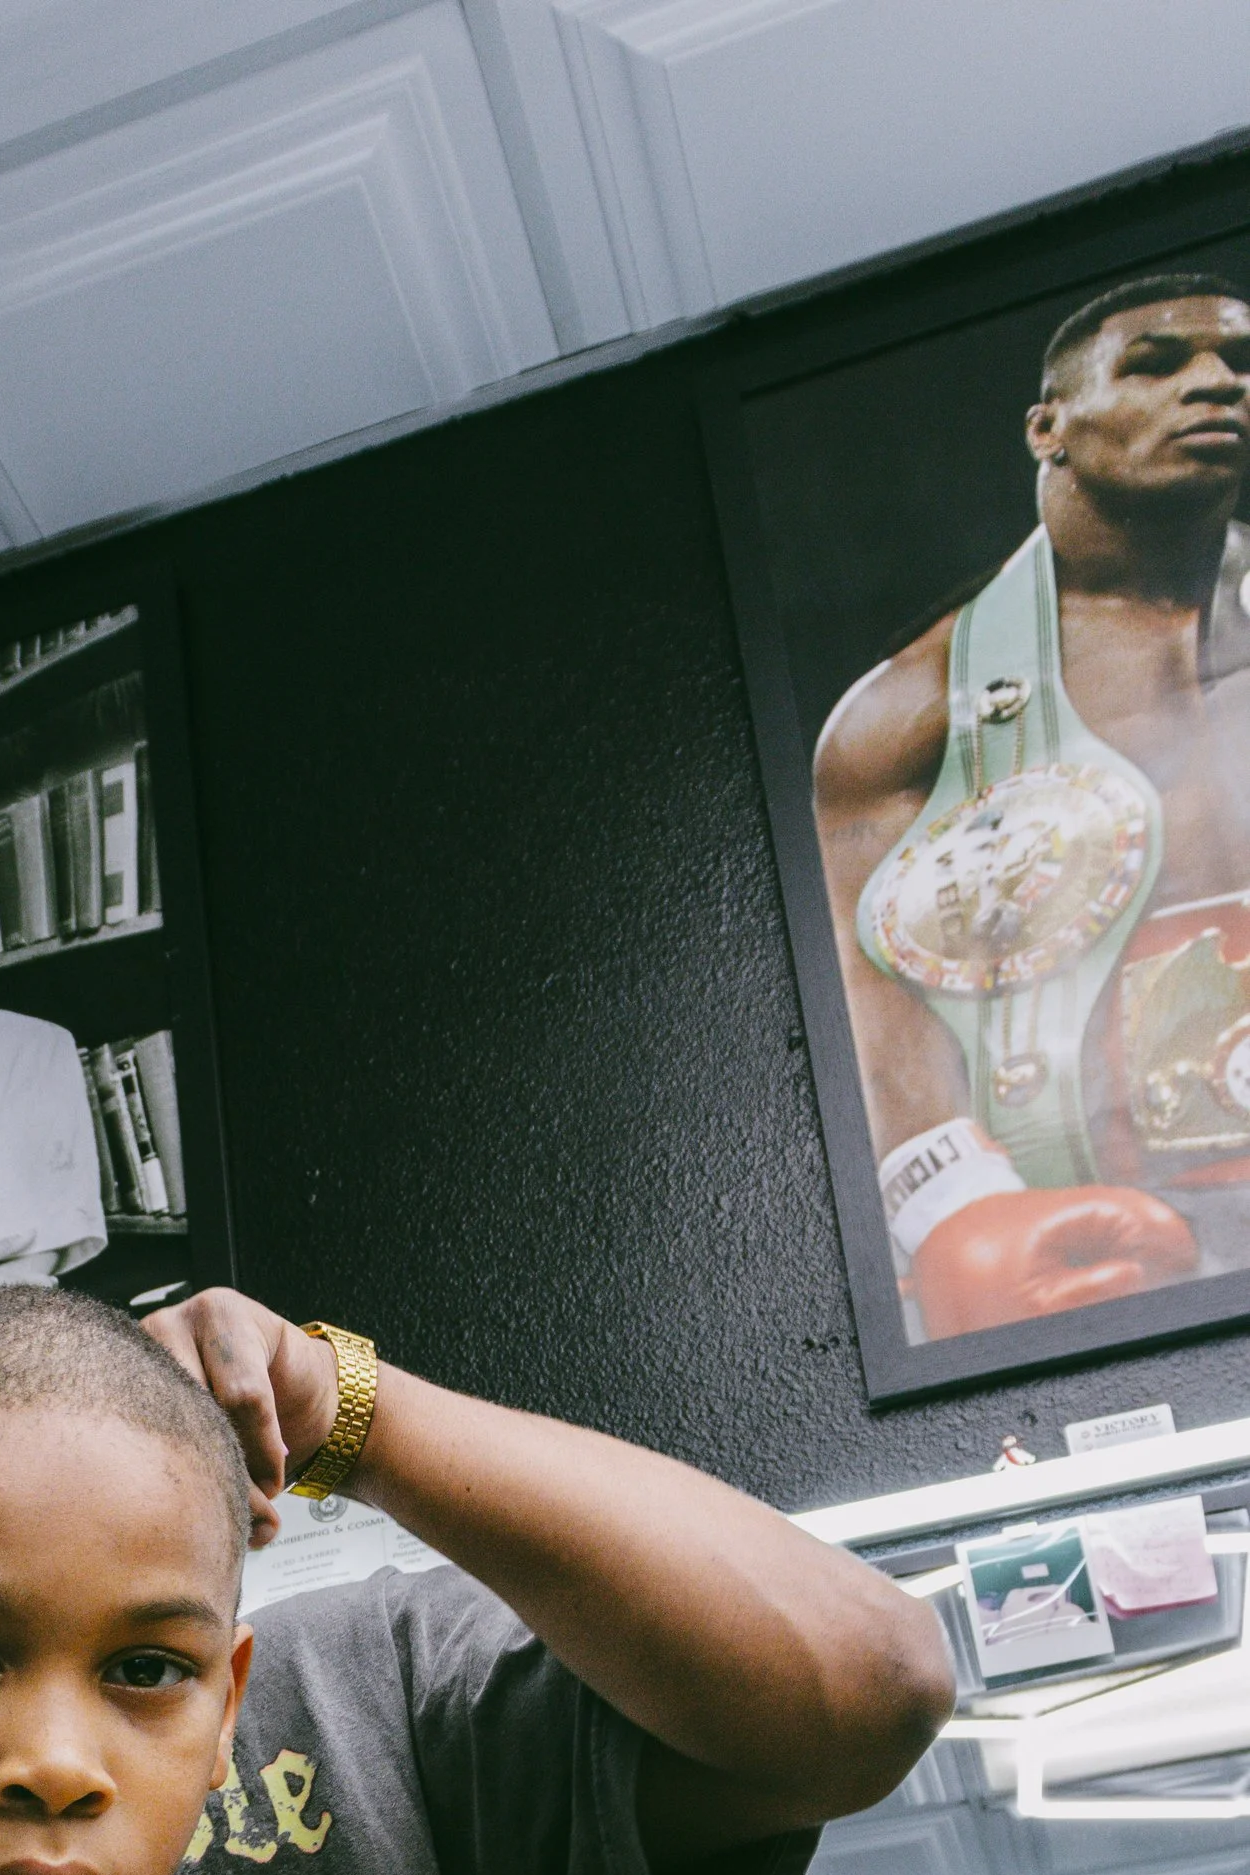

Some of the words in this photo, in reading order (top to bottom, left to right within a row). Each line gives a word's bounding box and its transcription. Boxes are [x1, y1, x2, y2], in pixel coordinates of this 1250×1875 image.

[1094, 1412, 1159, 1433] VICTORY
[269, 1527, 330, 1549] BARBERING
[334, 1524, 344, 1534] &
